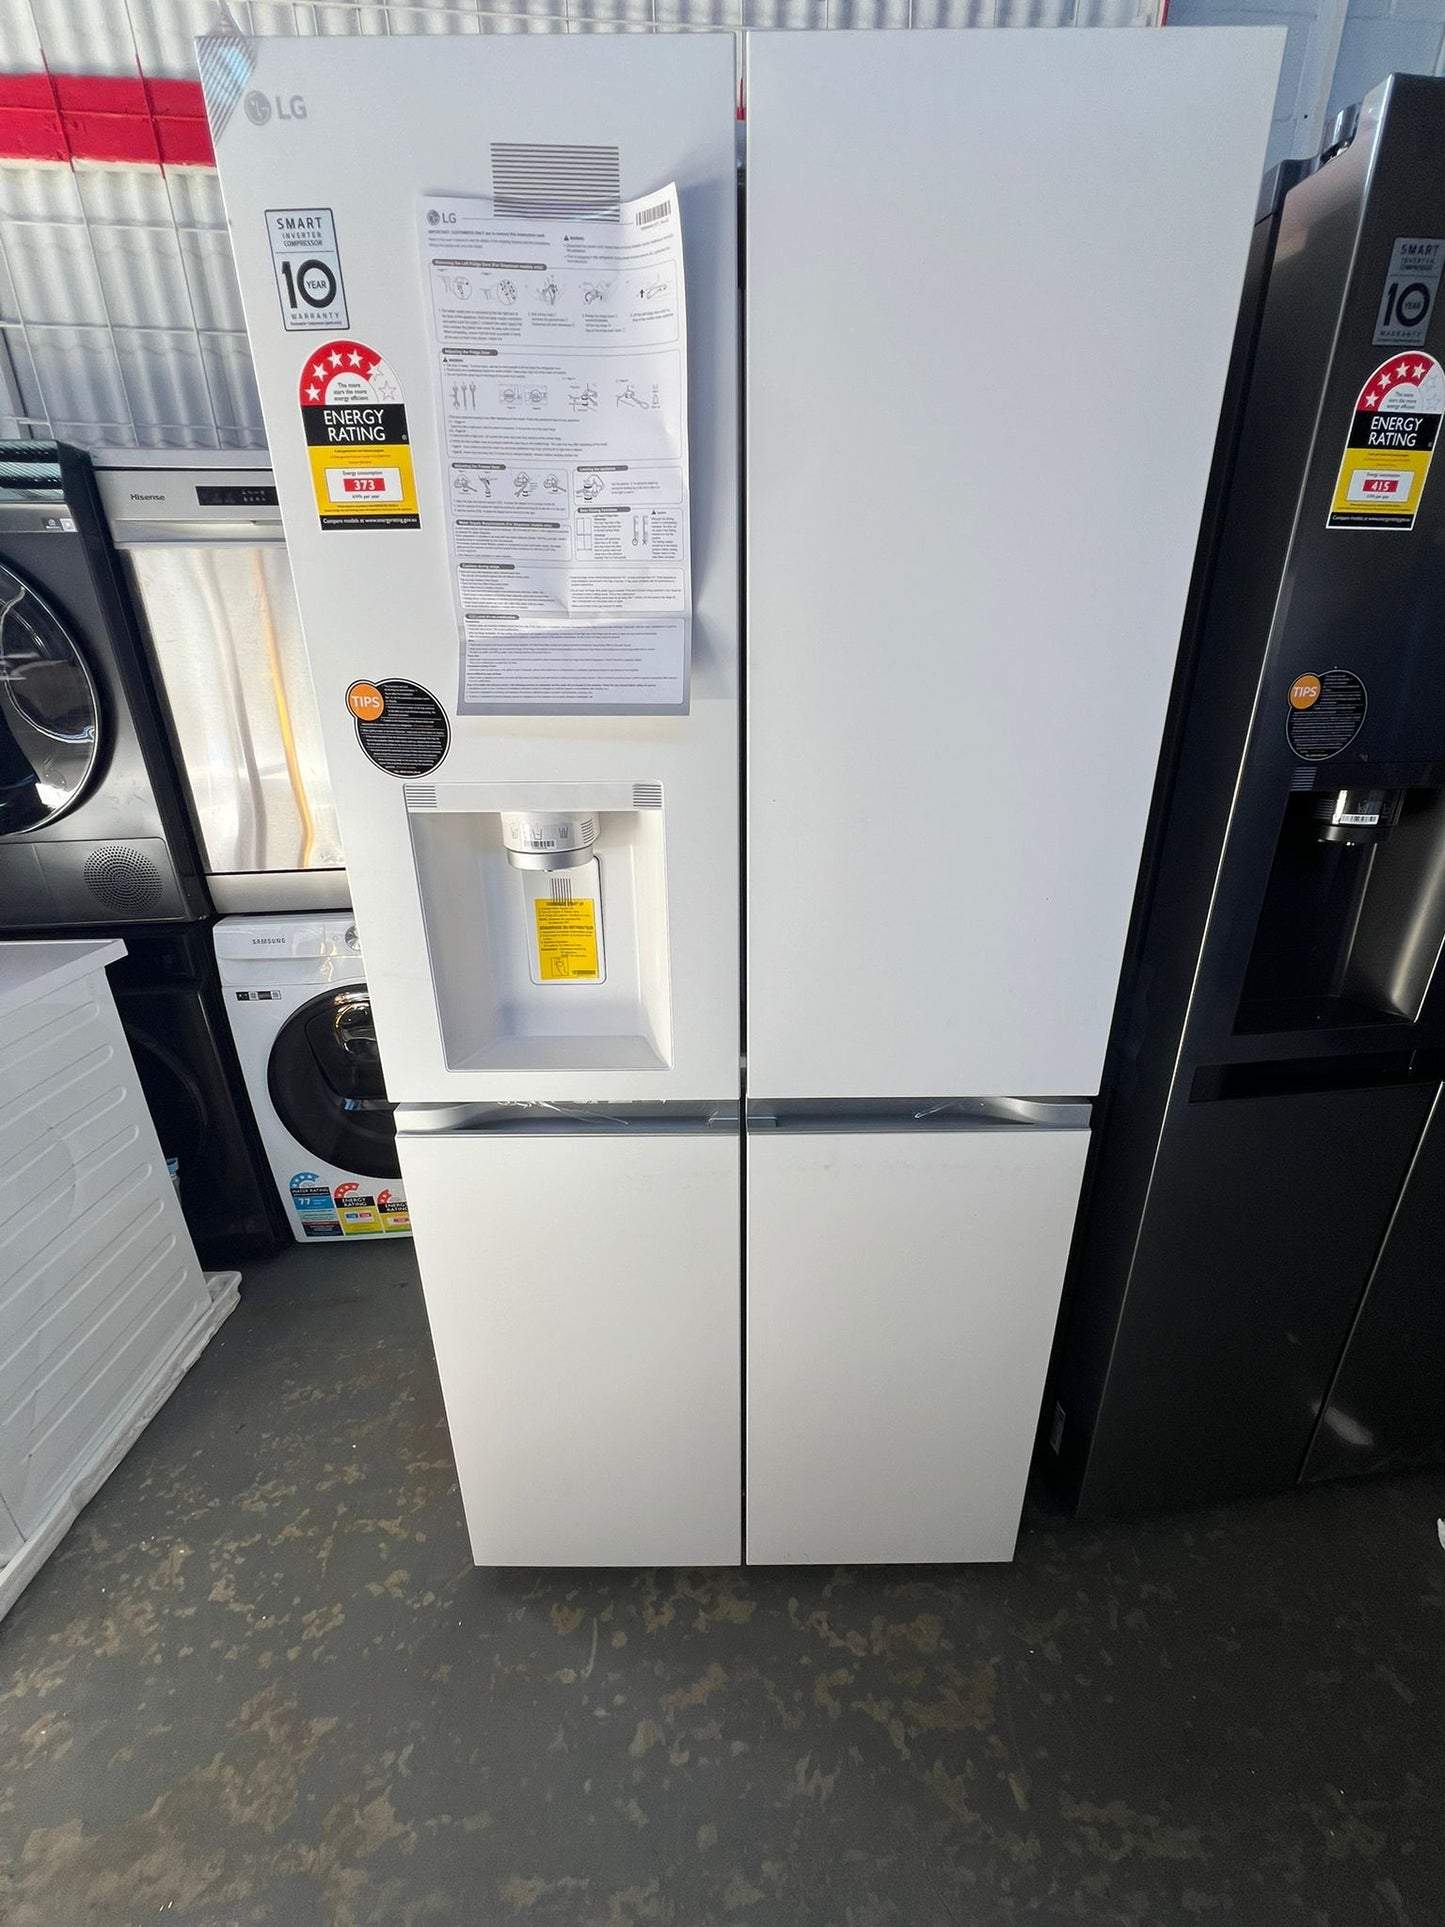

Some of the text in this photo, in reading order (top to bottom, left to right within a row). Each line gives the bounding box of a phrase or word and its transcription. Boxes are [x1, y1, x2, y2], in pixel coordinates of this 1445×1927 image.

[276, 95, 307, 120] LG
[277, 217, 322, 230] SMART
[442, 212, 457, 224] LG
[282, 231, 322, 239] INVERTER
[1401, 243, 1440, 256] SMART
[282, 259, 337, 309] 10
[306, 280, 327, 290] YEAR
[1383, 282, 1431, 327] 10
[290, 312, 340, 320] WARRANTY
[323, 409, 384, 425] ENERGY
[1370, 416, 1424, 432] ENERGY
[328, 427, 386, 442] RATING
[1368, 431, 1418, 447] RATING
[353, 480, 376, 491] 373
[1370, 481, 1391, 491] 415
[130, 493, 166, 501] Hisense
[1293, 686, 1318, 698] TIPS
[351, 695, 381, 709] TIPS
[252, 937, 286, 945] SAMSUNG
